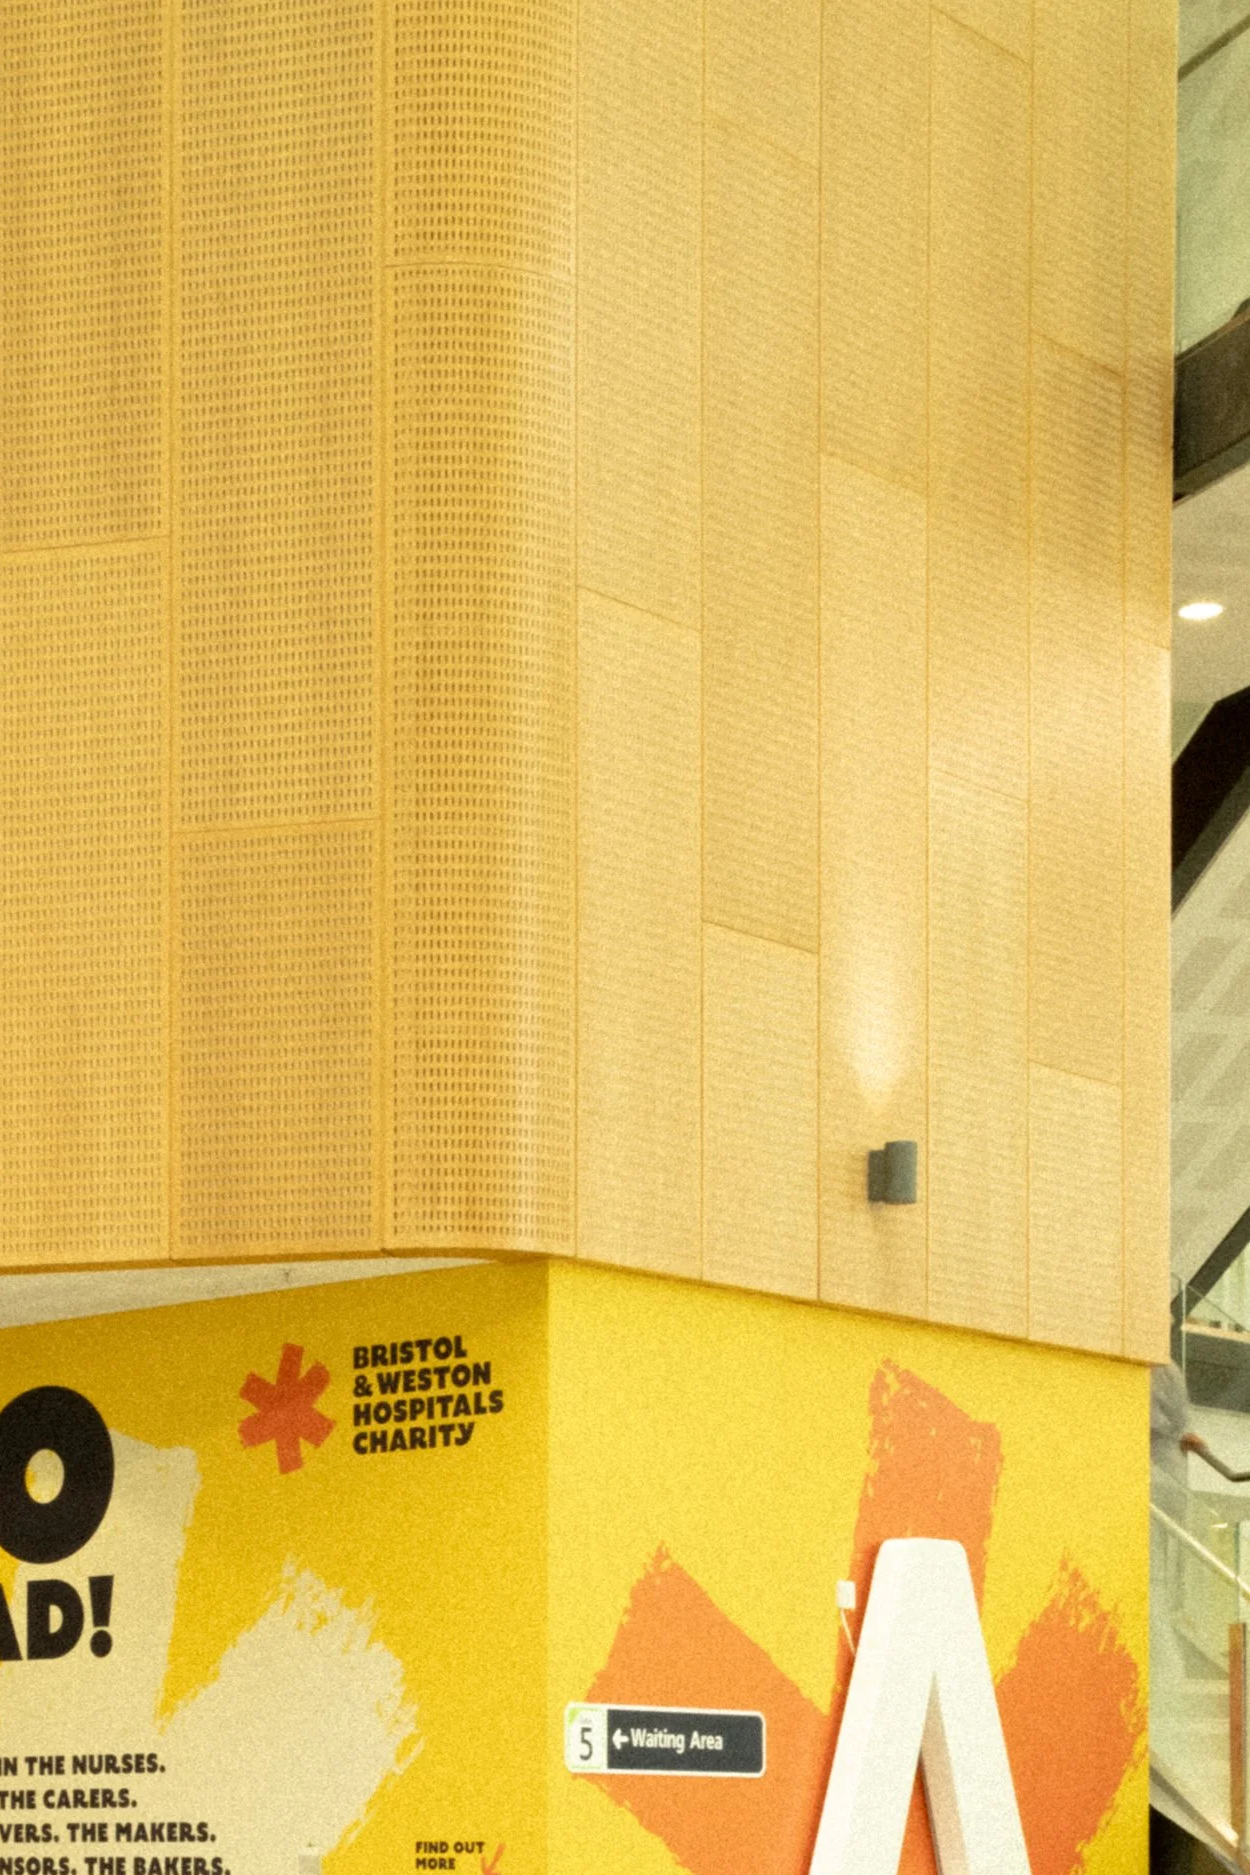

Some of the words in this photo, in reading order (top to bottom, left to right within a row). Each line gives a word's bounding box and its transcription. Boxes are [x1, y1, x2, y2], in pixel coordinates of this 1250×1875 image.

[353, 1335, 467, 1369] BRISTOL
[353, 1375, 373, 1398] &
[377, 1362, 492, 1395] WESTON
[353, 1390, 505, 1427] HOSPITALS
[353, 1422, 476, 1455] CHARITY
[579, 1727, 593, 1761] 5
[630, 1728, 685, 1754] Waiting
[689, 1731, 724, 1750] Area
[25, 1755, 65, 1775] THE
[72, 1753, 165, 1775] NURSES.
[43, 1788, 137, 1809] CARERS.
[67, 1822, 108, 1843] THE
[115, 1822, 216, 1843] MAKERS.
[416, 1841, 449, 1854] FIND
[453, 1841, 485, 1854] OUT
[416, 1858, 456, 1870] MORE
